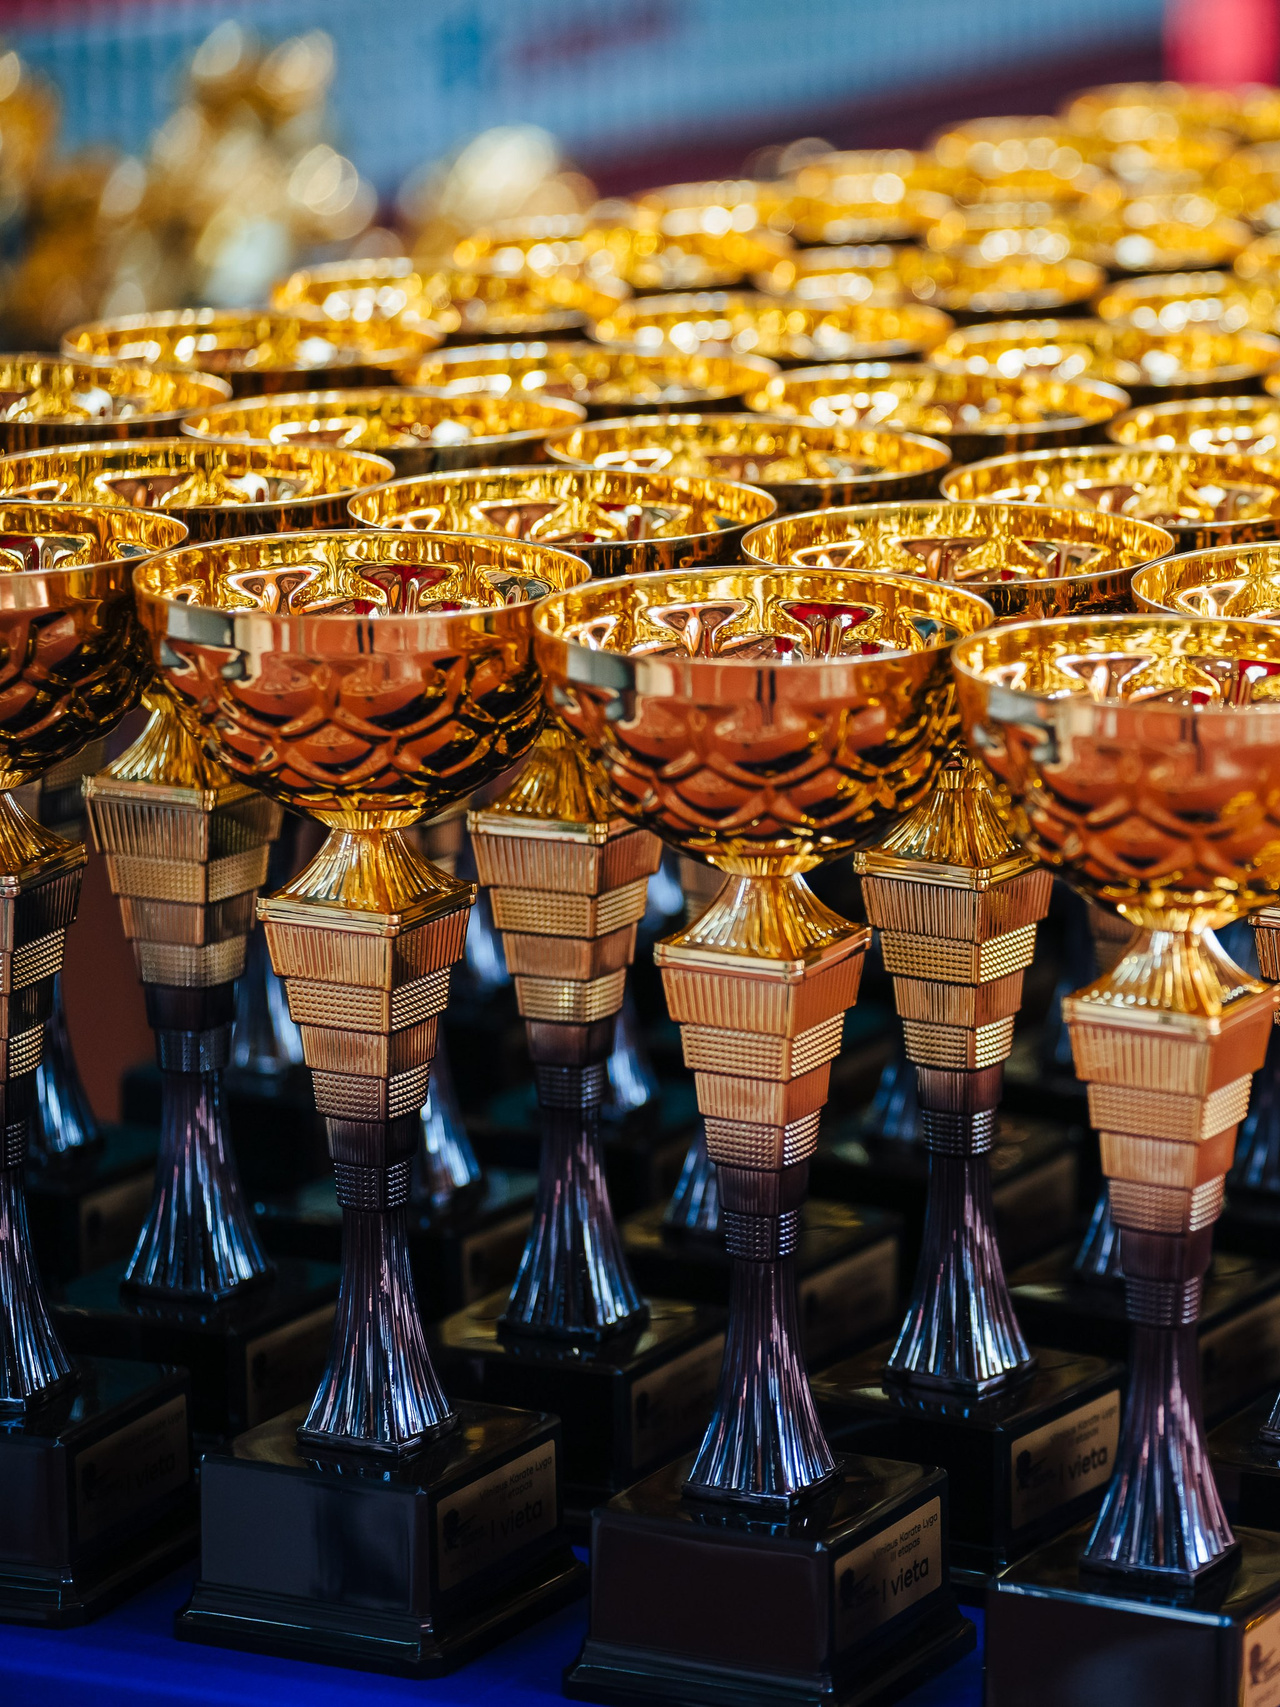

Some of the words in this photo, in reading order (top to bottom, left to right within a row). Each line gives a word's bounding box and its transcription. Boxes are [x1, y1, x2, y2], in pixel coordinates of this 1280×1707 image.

[136, 1453, 176, 1489] vieta
[509, 1466, 534, 1486] Karate
[534, 1456, 552, 1472] Lyga
[1068, 1446, 1108, 1480] vieta
[508, 1479, 532, 1500] etapas
[500, 1498, 542, 1538] vieta
[899, 1524, 921, 1544] Karate
[922, 1513, 938, 1528] Lyga
[898, 1537, 920, 1557] etapas
[891, 1557, 928, 1596] vieta
